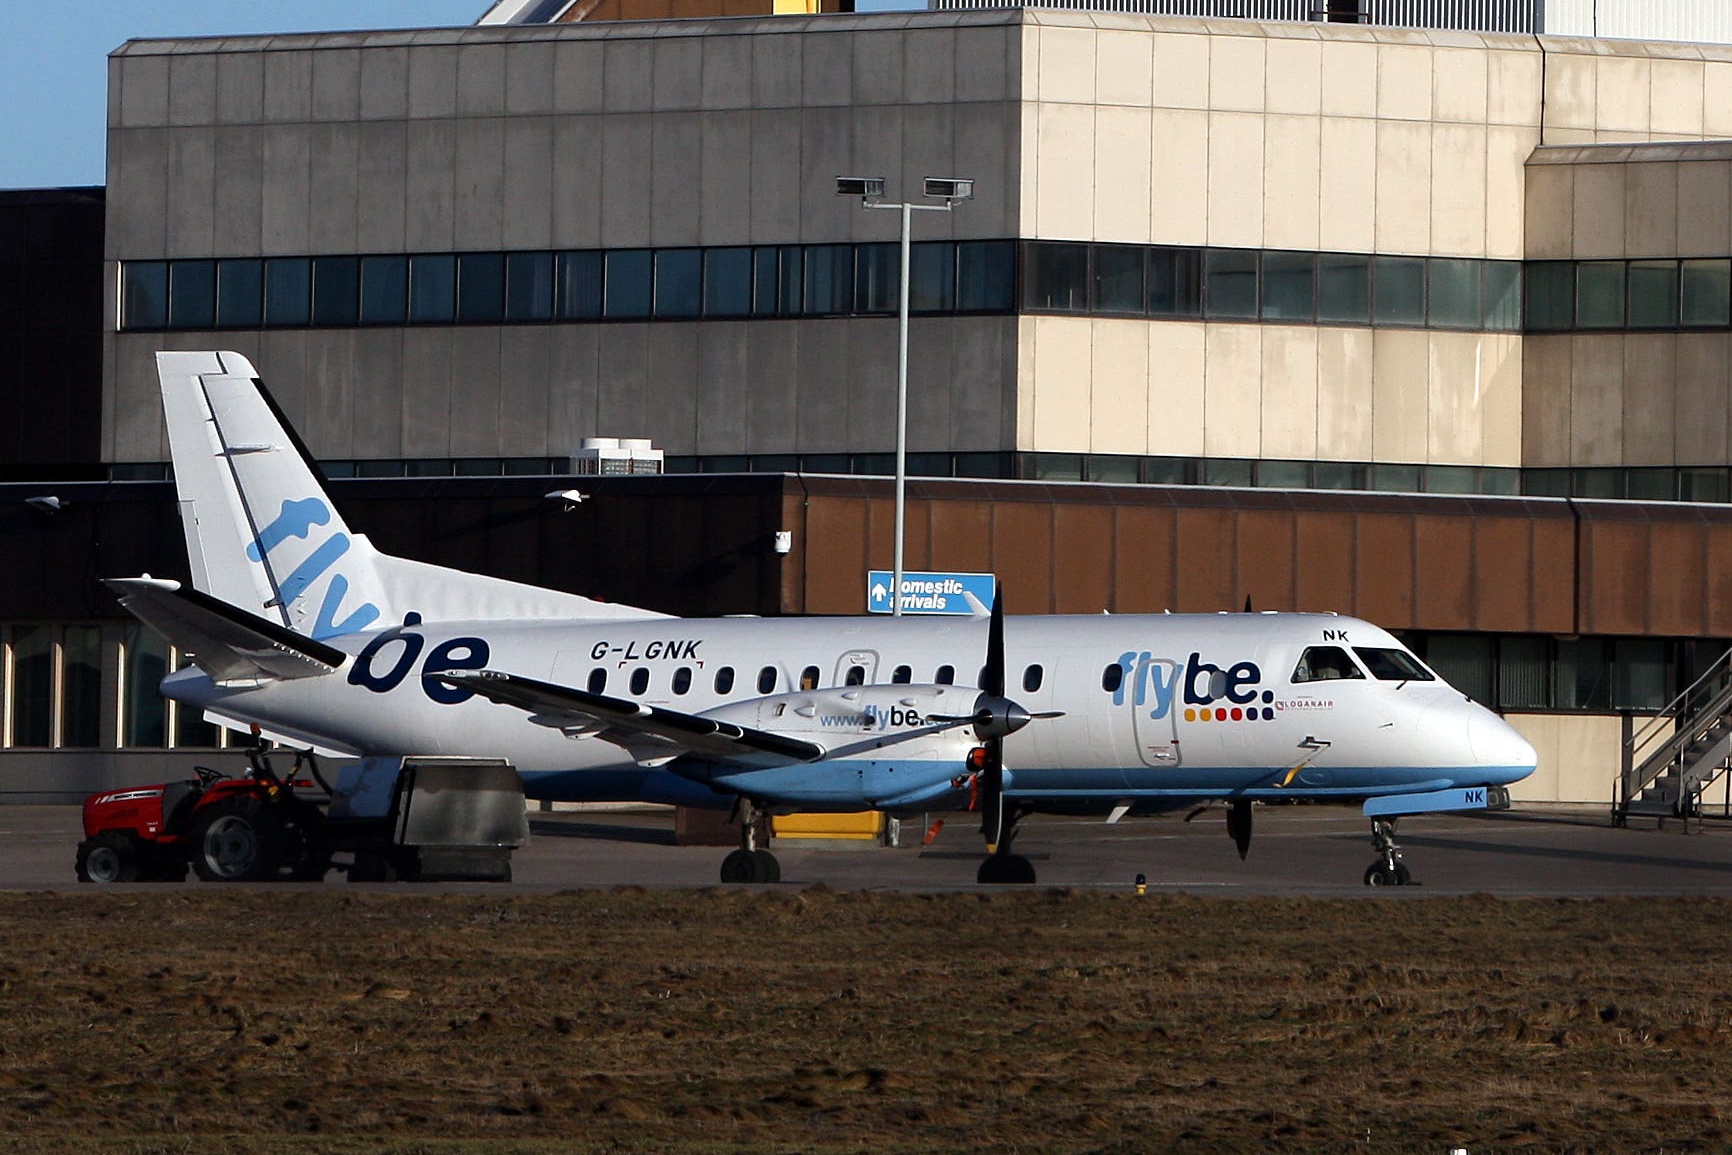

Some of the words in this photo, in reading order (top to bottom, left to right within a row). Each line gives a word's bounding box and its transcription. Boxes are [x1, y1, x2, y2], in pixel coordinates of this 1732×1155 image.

[1322, 629, 1350, 642] NK
[590, 640, 703, 660] G-LGNK
[1465, 790, 1483, 803] NK
